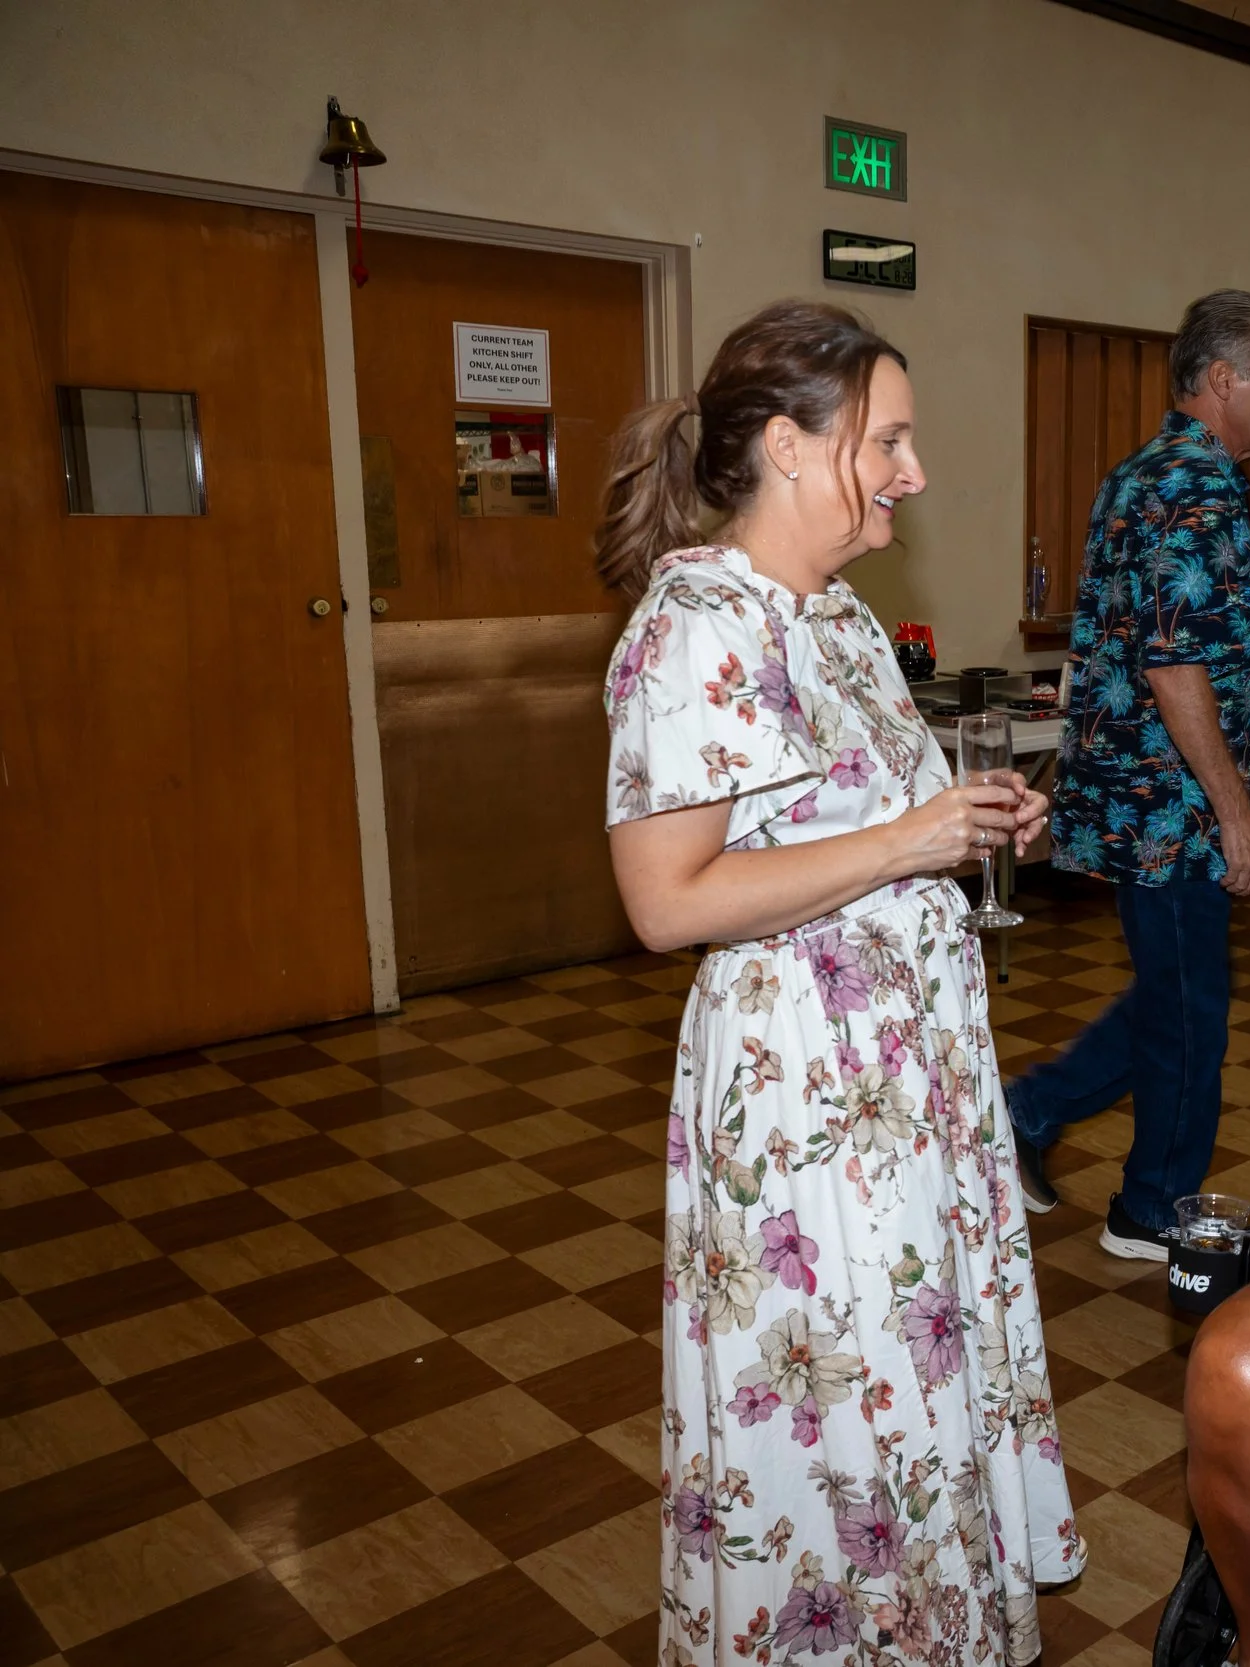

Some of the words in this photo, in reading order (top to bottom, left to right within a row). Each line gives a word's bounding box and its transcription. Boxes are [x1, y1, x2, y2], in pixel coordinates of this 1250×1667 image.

[831, 128, 897, 191] EXIT
[471, 334, 511, 345] CURRENT
[512, 338, 534, 347] TEAM
[472, 348, 509, 358] KITCHEN
[510, 351, 533, 360] SHIFT
[469, 360, 493, 371] ONLY,
[494, 363, 510, 371] ALL
[511, 364, 538, 373] OTHER
[467, 373, 498, 383] PLEASE
[499, 376, 520, 384] KEEP
[521, 377, 541, 386] OUT!
[1169, 1263, 1210, 1293] drive
